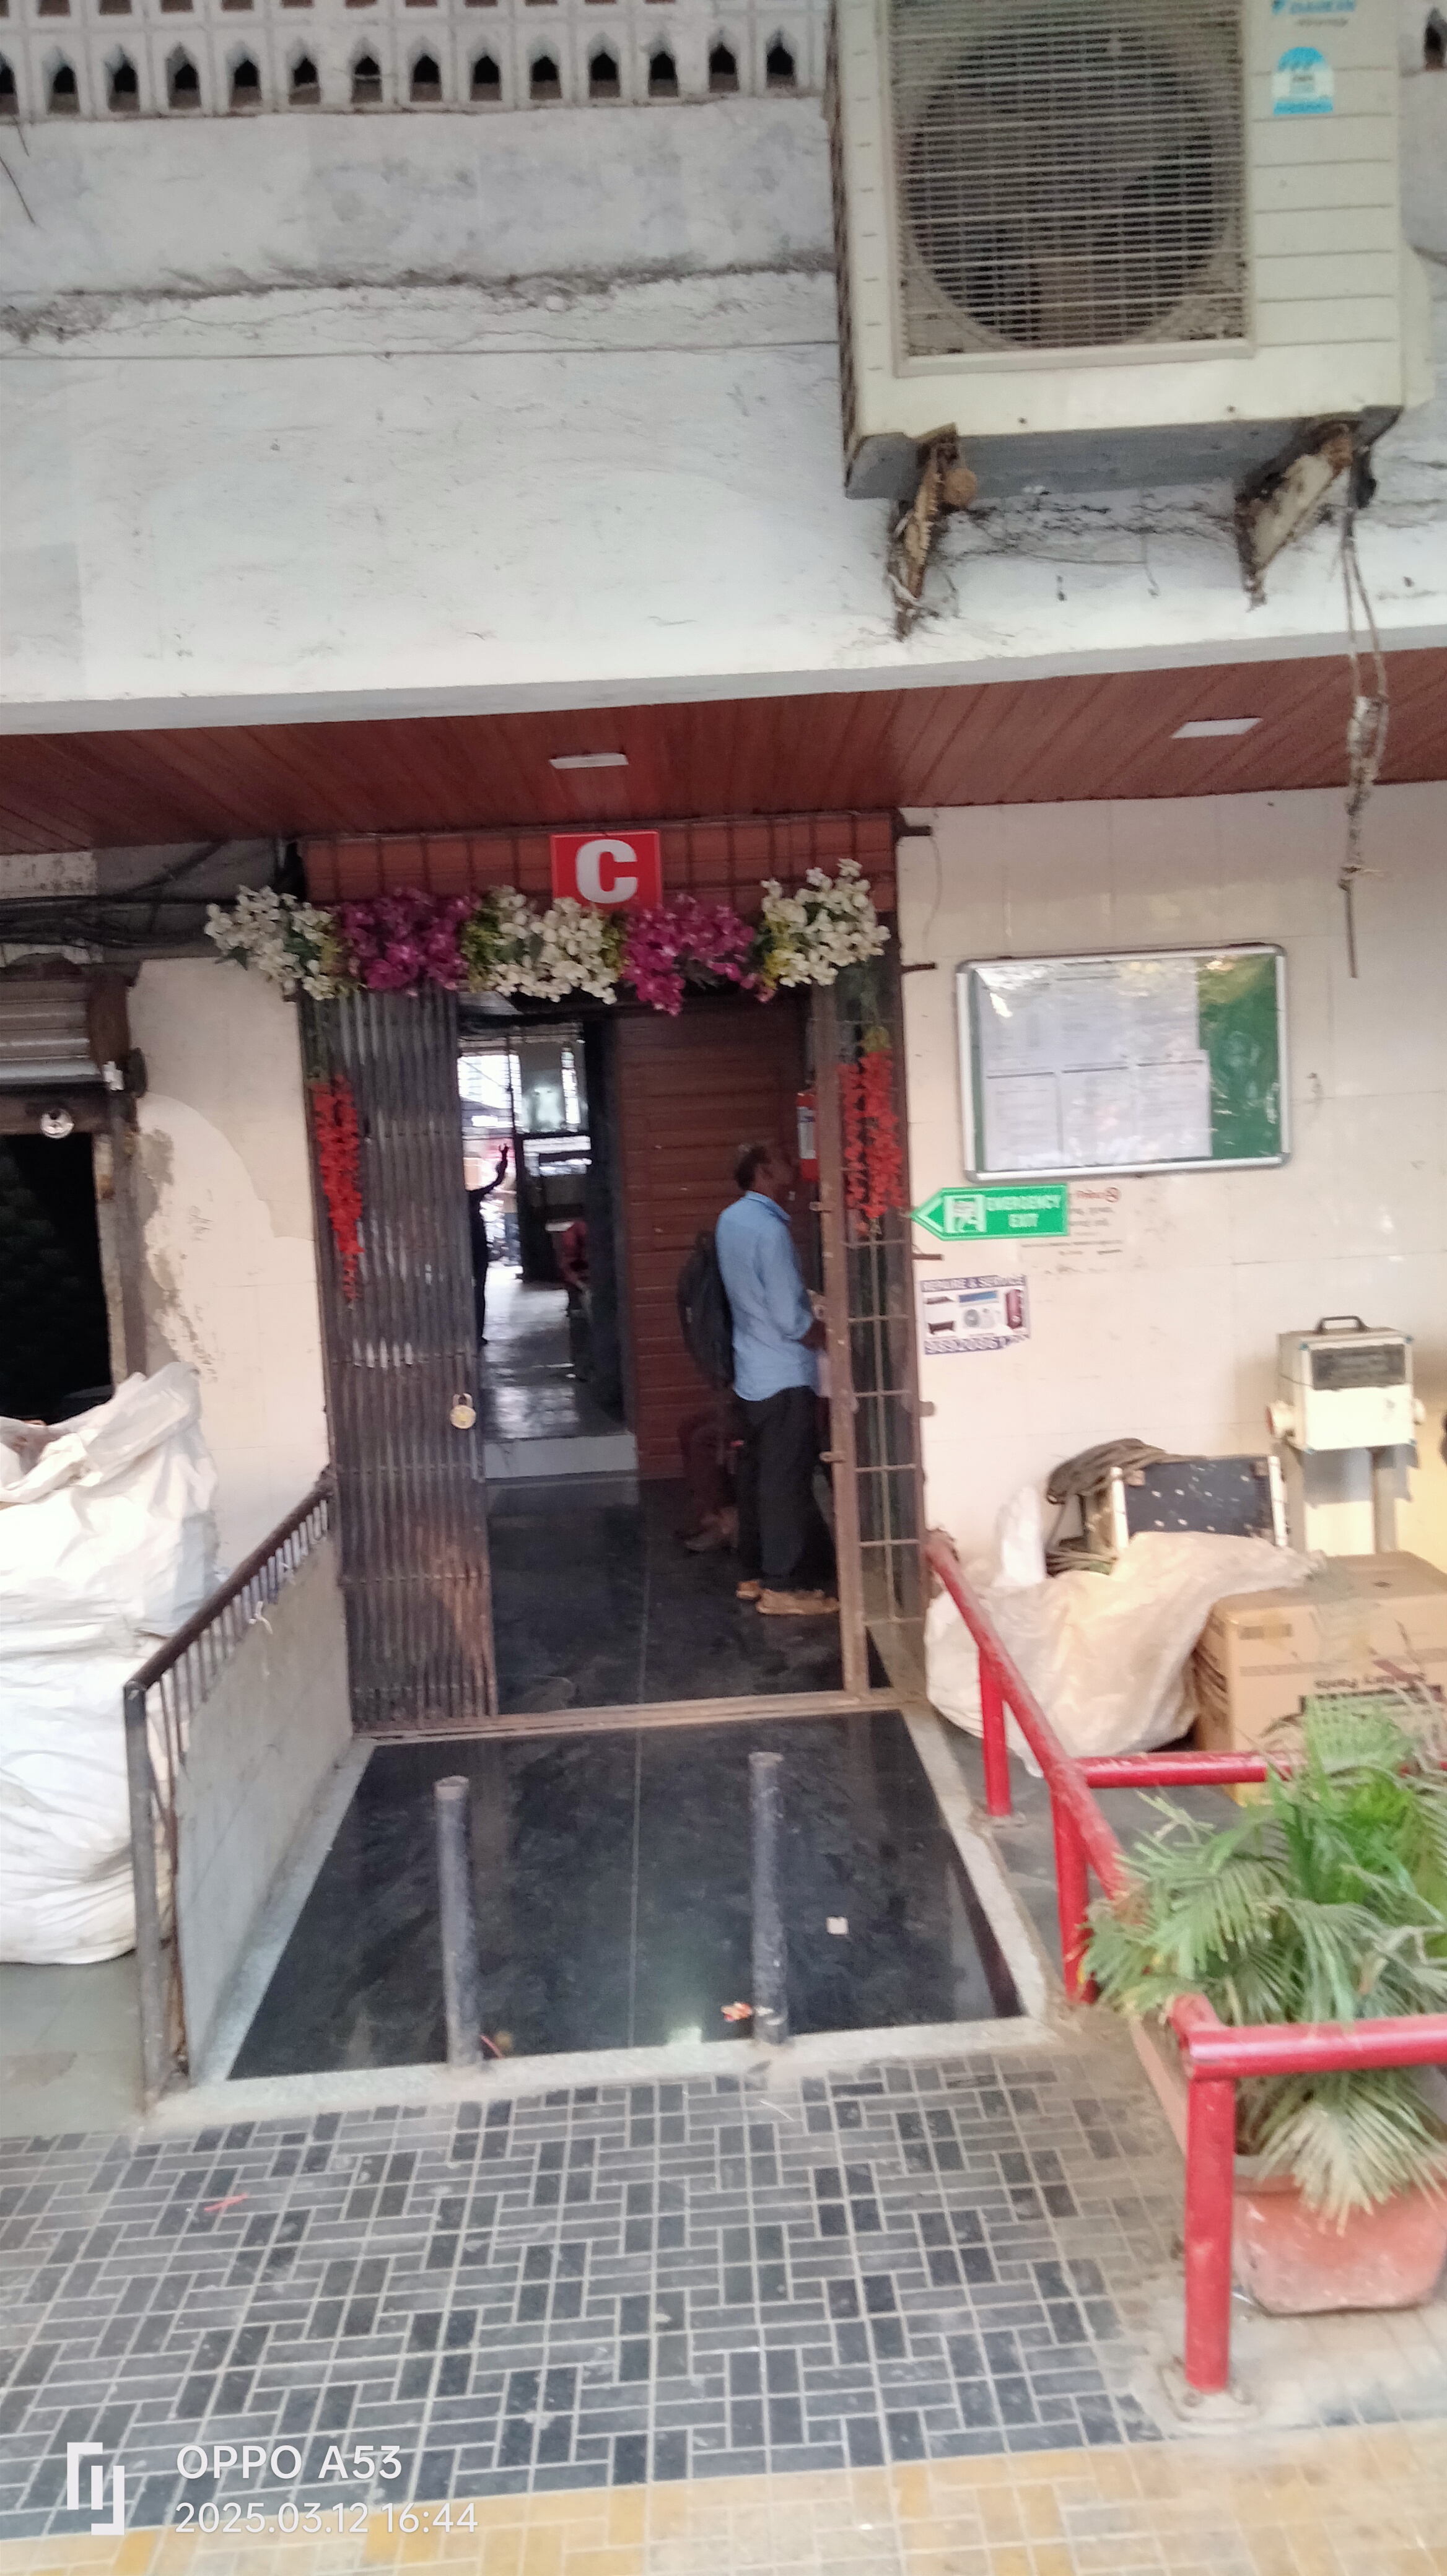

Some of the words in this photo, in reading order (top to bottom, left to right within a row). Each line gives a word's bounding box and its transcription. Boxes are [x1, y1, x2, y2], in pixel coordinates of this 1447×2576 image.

[575, 839, 637, 903] C
[985, 1195, 1060, 1211] EMERGENCY
[1008, 1213, 1039, 1227] EXIT
